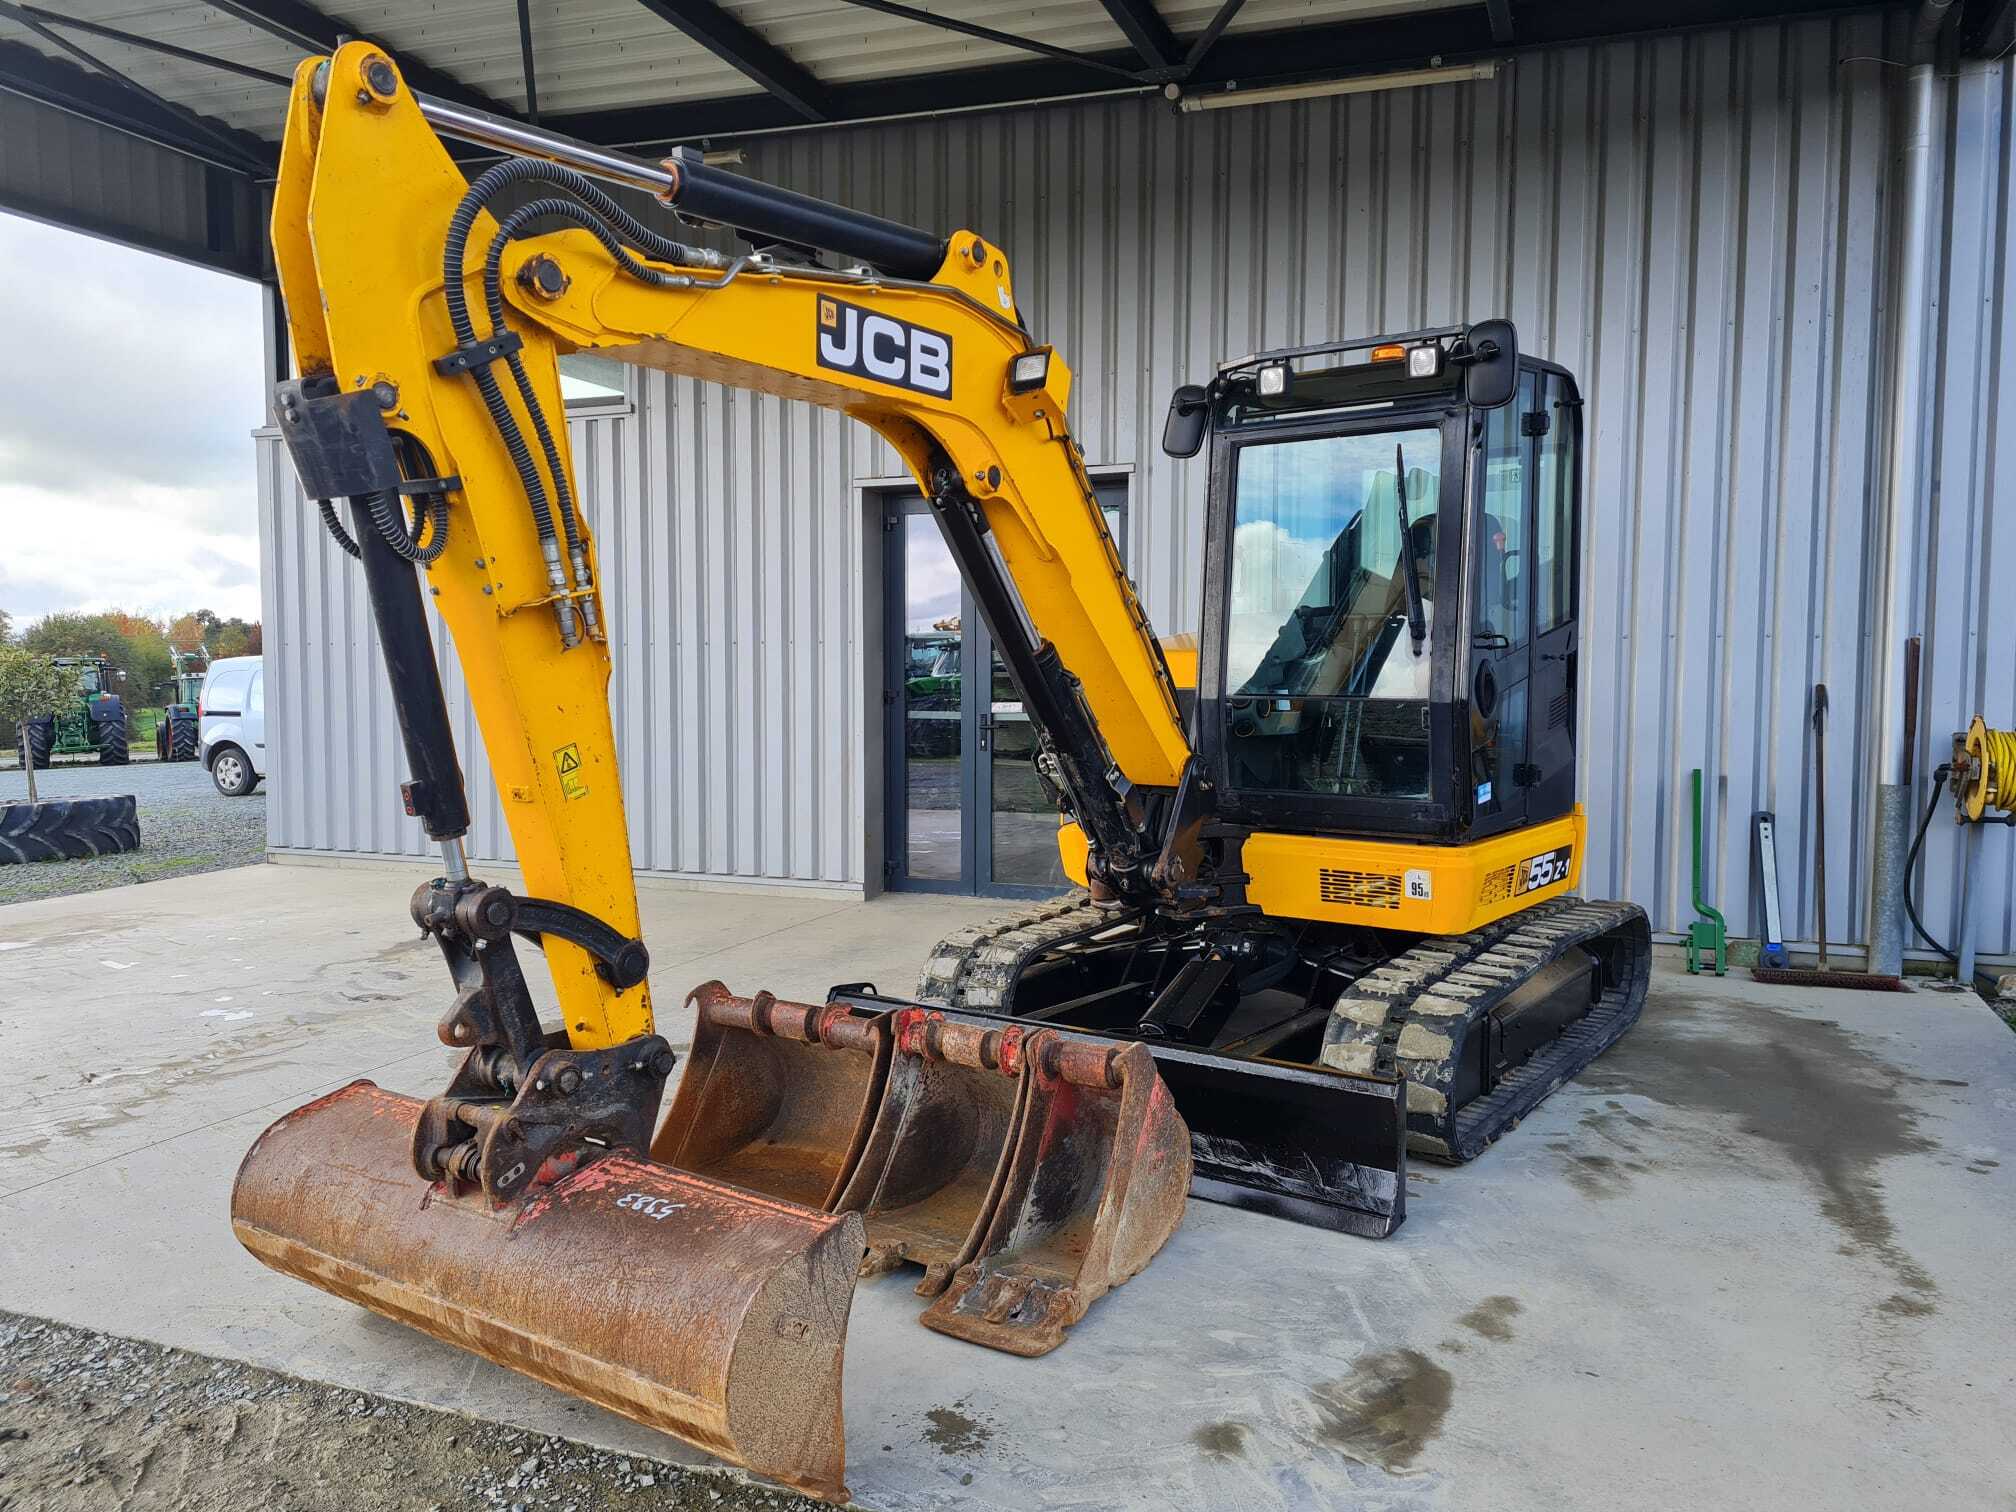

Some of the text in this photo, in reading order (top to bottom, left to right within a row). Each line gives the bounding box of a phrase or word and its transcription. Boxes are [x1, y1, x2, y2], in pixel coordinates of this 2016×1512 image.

[820, 308, 949, 391] JCB
[1412, 882, 1423, 896] 95
[1528, 851, 1555, 889] 55
